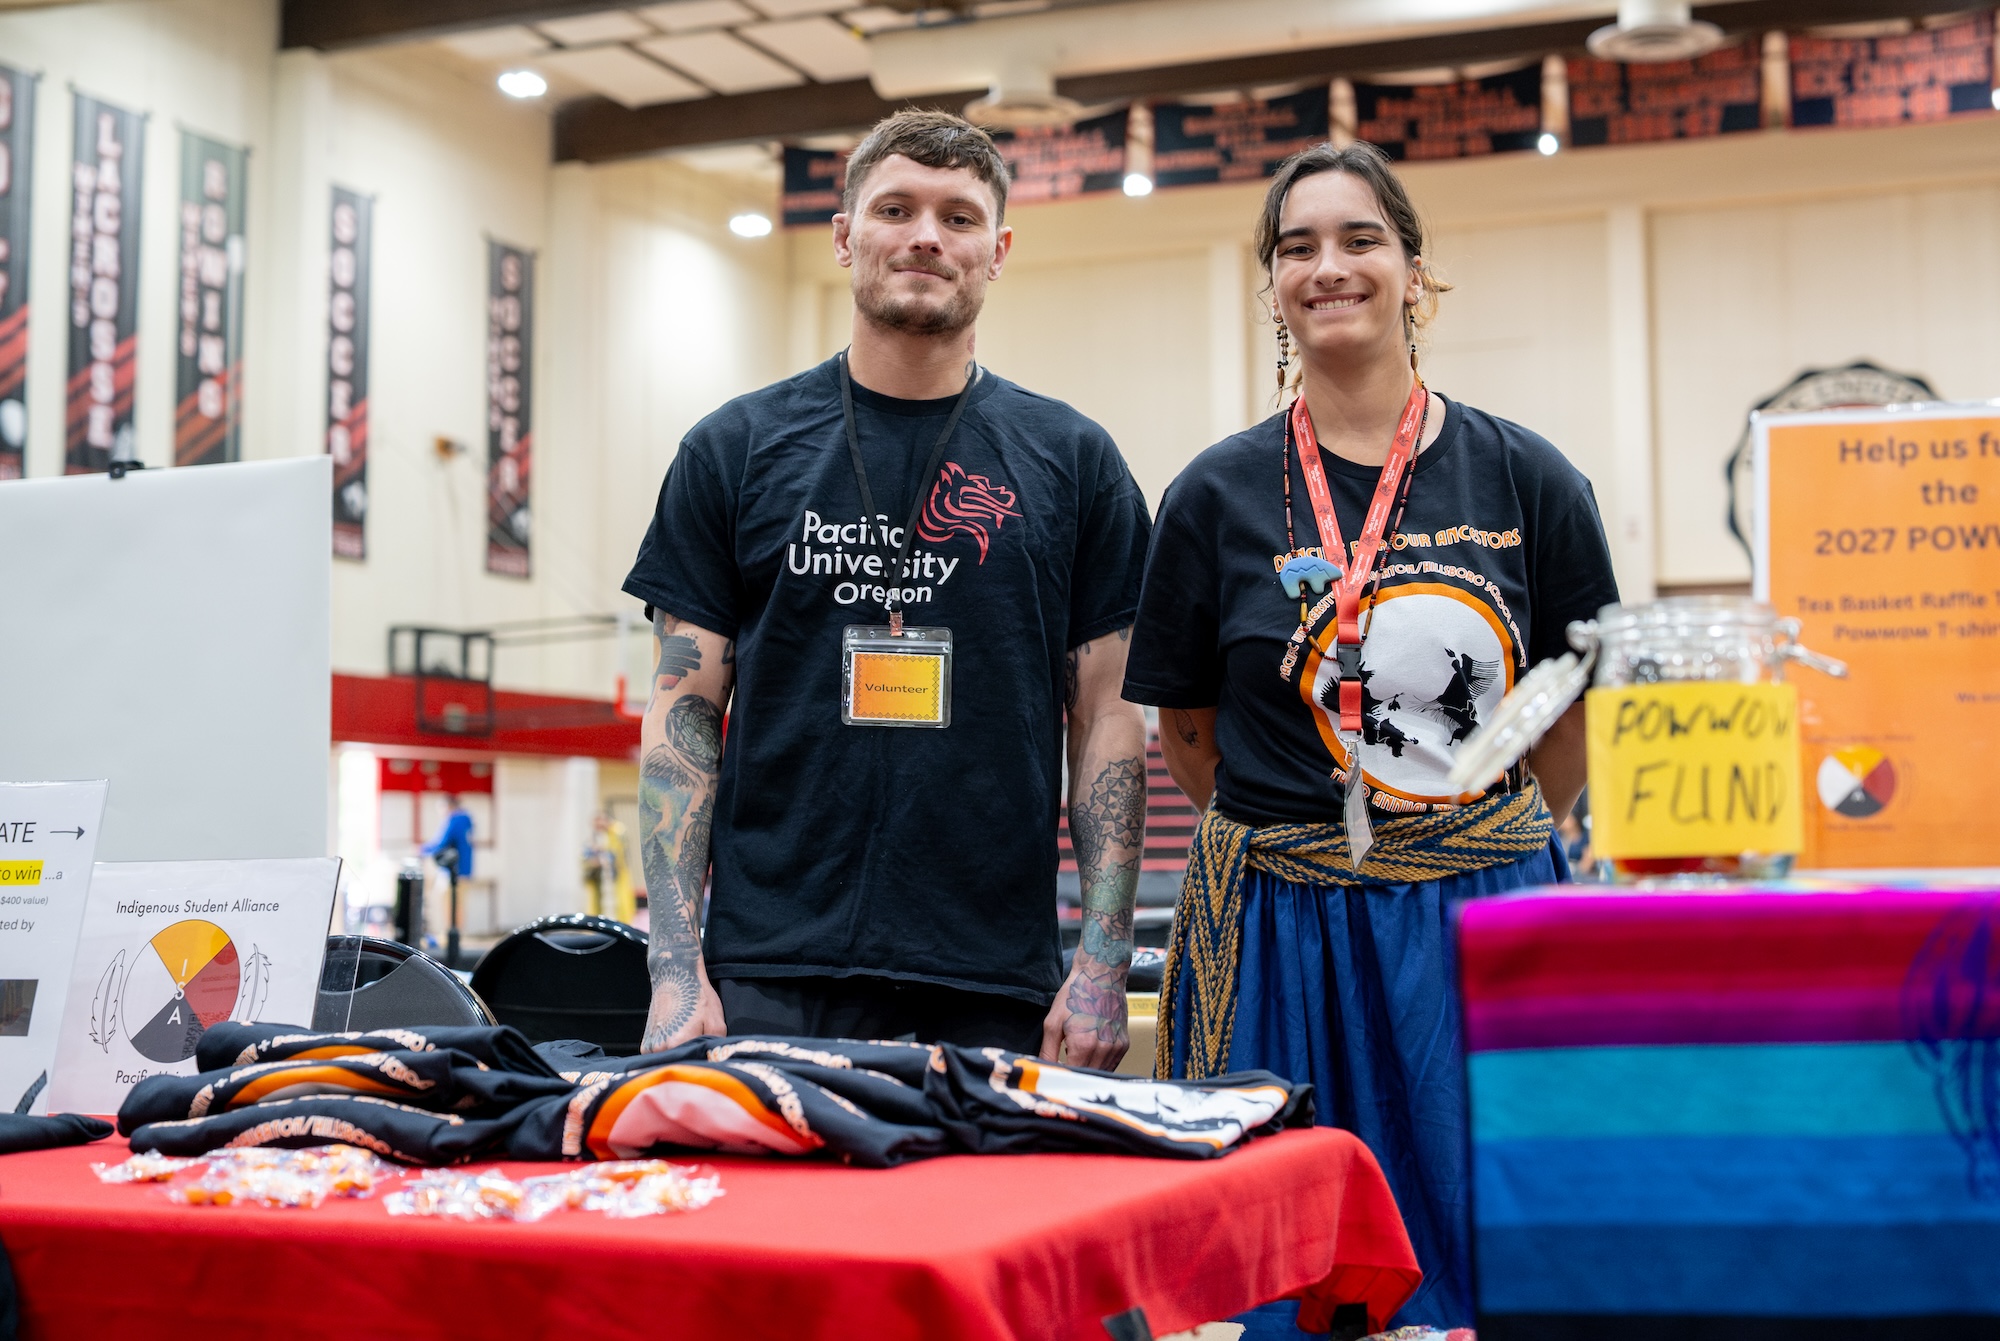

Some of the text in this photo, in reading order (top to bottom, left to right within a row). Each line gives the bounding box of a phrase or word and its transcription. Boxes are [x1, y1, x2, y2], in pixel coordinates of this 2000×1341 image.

[88, 112, 122, 448] LACROSSE
[199, 159, 227, 418] ROWING
[329, 202, 357, 465] SOCCER
[499, 254, 523, 494] SOCCER
[1839, 434, 1919, 468] Help
[1930, 438, 1969, 459] us
[1921, 478, 1980, 505] the
[1391, 532, 1431, 551] OUR
[1435, 524, 1522, 550] ANCESTORS
[1815, 528, 1897, 556] 2027
[865, 683, 929, 694] Volunteer
[1626, 758, 1788, 825] FUND
[16, 864, 42, 880] win
[23, 896, 48, 906] value)
[116, 899, 279, 917] Indigenous Student Alliance
[21, 919, 35, 933] by
[167, 1005, 182, 1024] A
